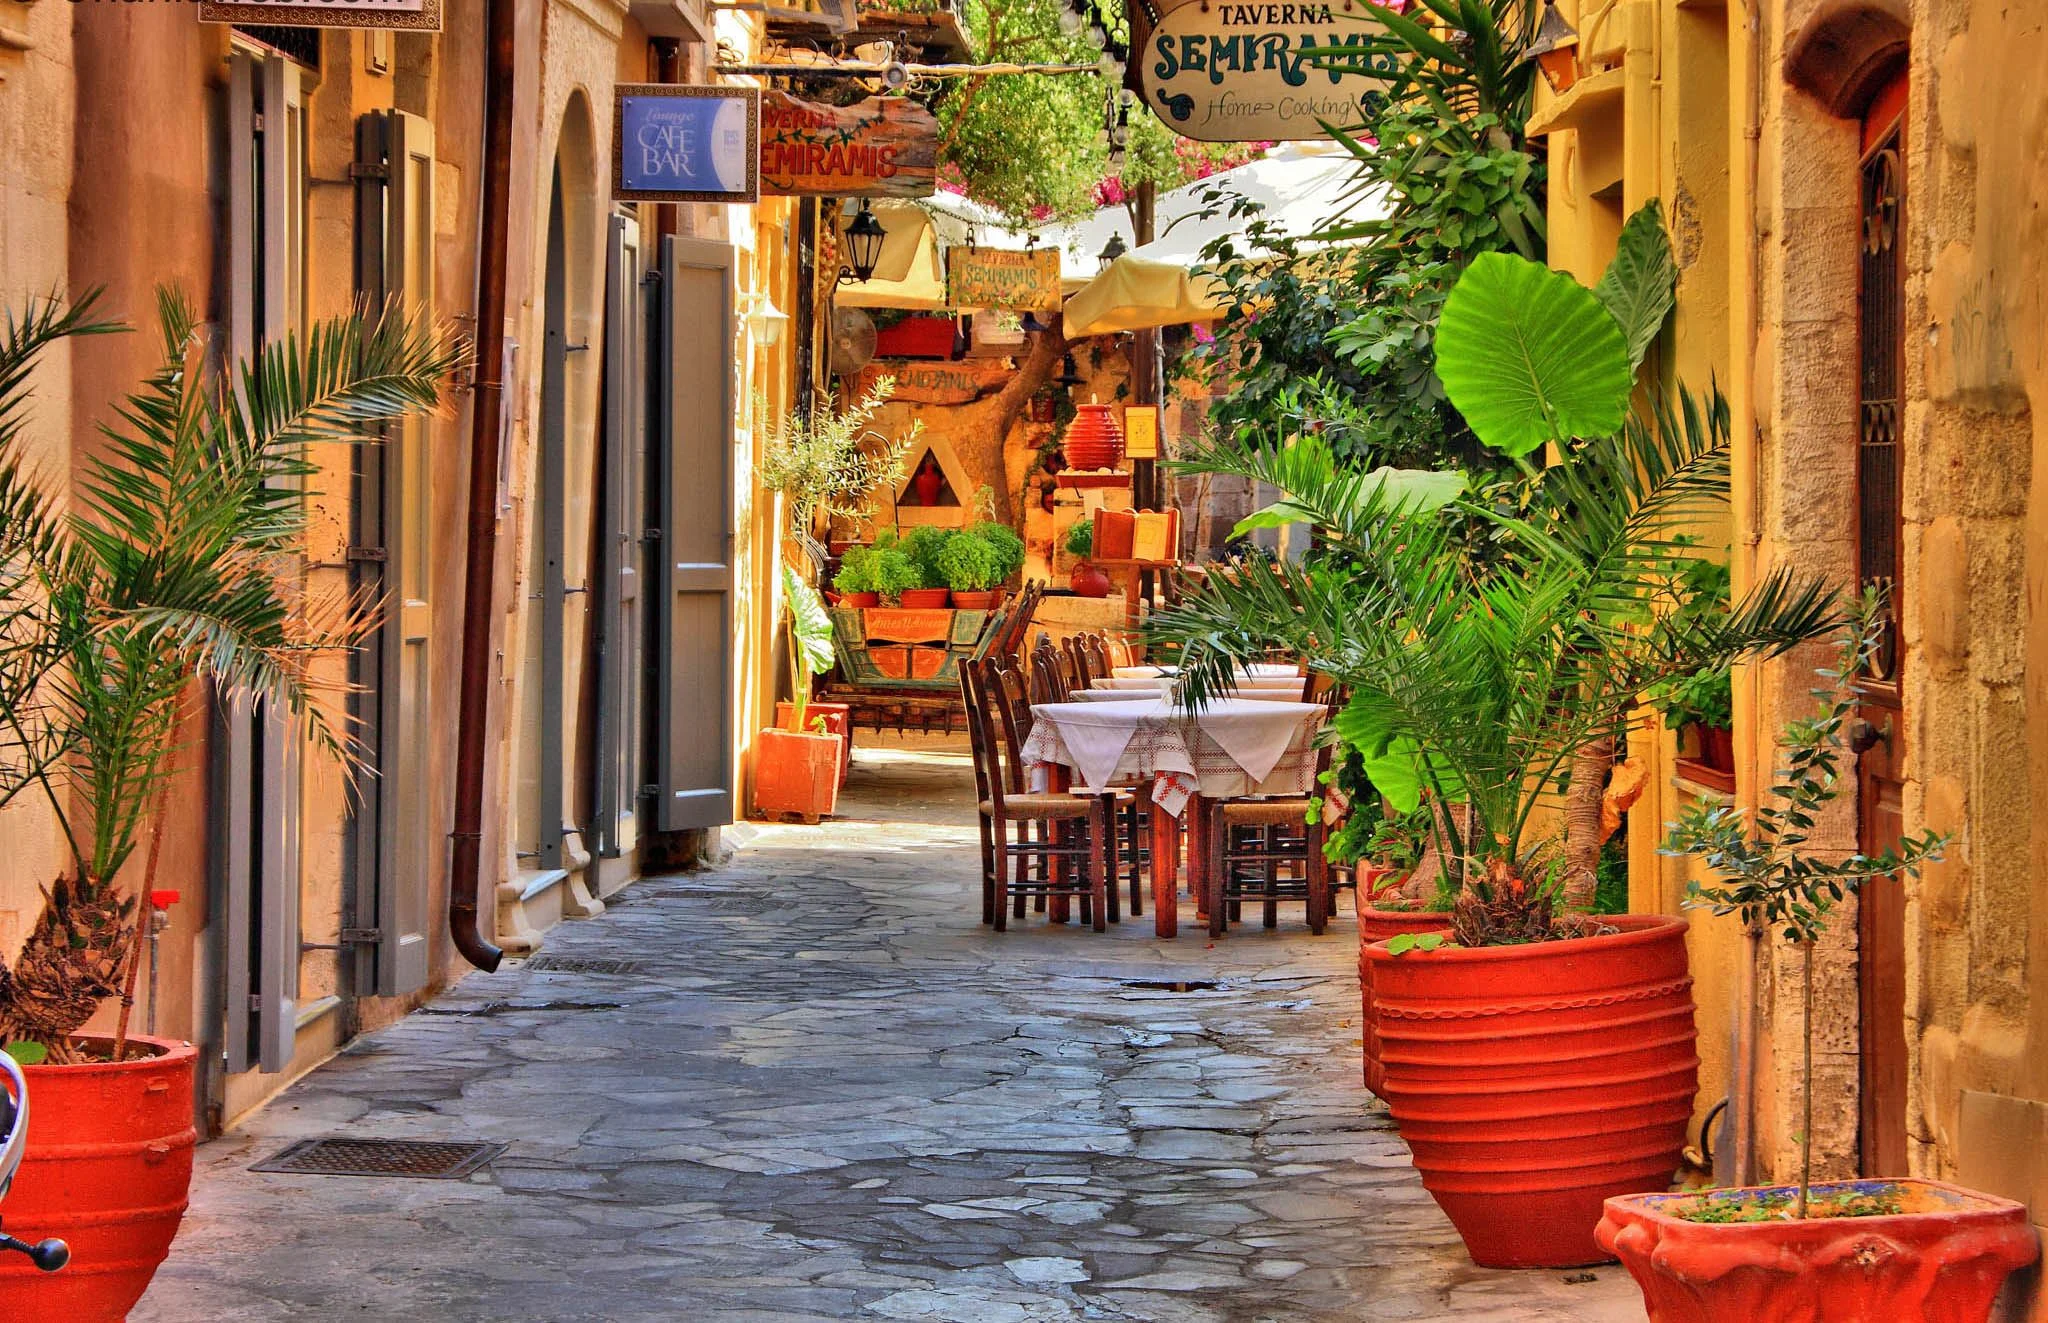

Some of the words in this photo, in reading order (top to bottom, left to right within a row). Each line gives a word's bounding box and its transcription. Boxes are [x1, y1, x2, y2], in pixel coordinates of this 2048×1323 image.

[1218, 4, 1336, 26] TAVERNA
[761, 107, 837, 130] VERNA
[1201, 90, 1273, 127] Home
[1278, 95, 1354, 126] Cooking
[641, 148, 697, 177] BAR
[760, 143, 898, 179] EMIRAMIS
[982, 252, 1026, 266] TAVERNA
[965, 264, 1038, 290] SEMIRAMIS
